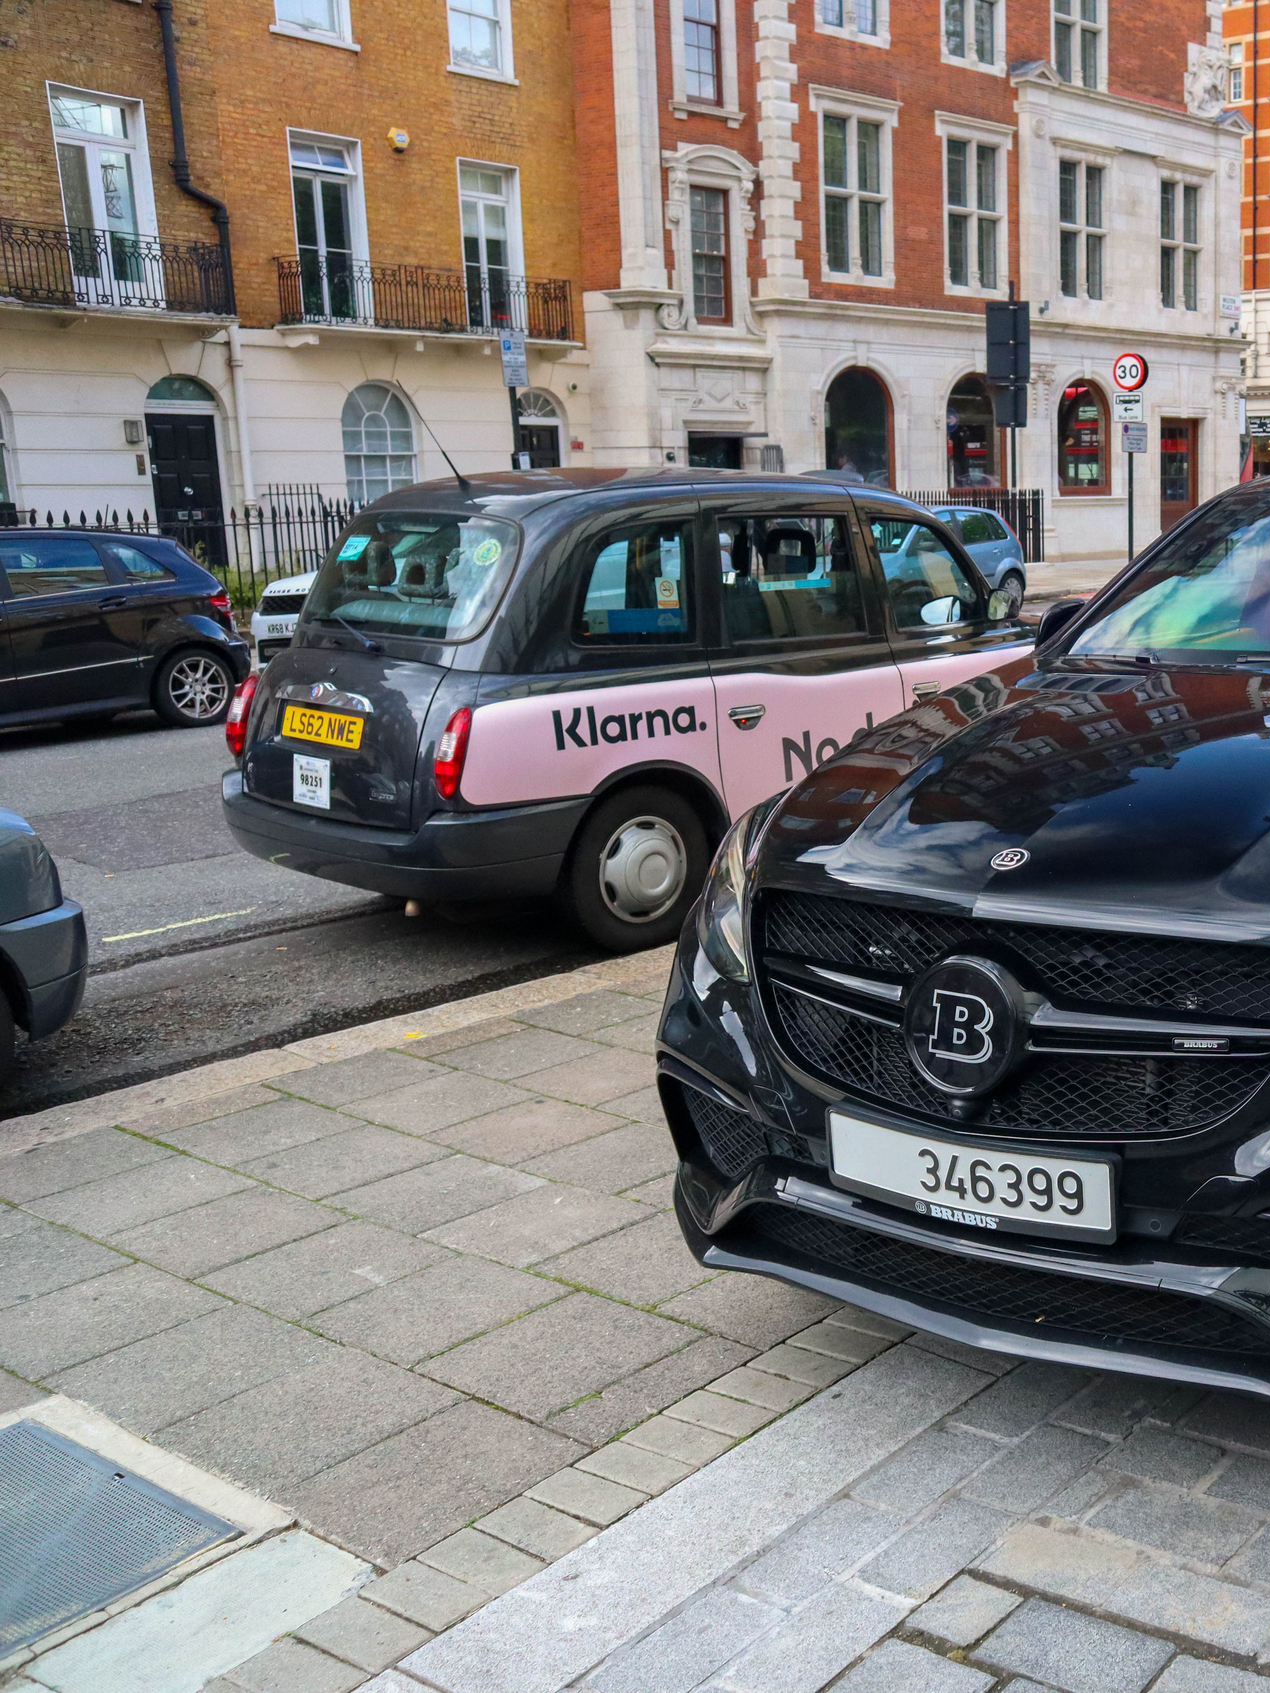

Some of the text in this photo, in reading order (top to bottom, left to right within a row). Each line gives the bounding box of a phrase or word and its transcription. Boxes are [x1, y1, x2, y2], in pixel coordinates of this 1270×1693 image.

[1117, 364, 1139, 379] 30
[289, 710, 358, 744] LS62 NWE
[551, 705, 707, 751] Klarna.
[300, 773, 323, 789] 98251
[928, 988, 994, 1064] B
[1183, 1041, 1218, 1049] BRABUS
[917, 1147, 1085, 1216] 346399
